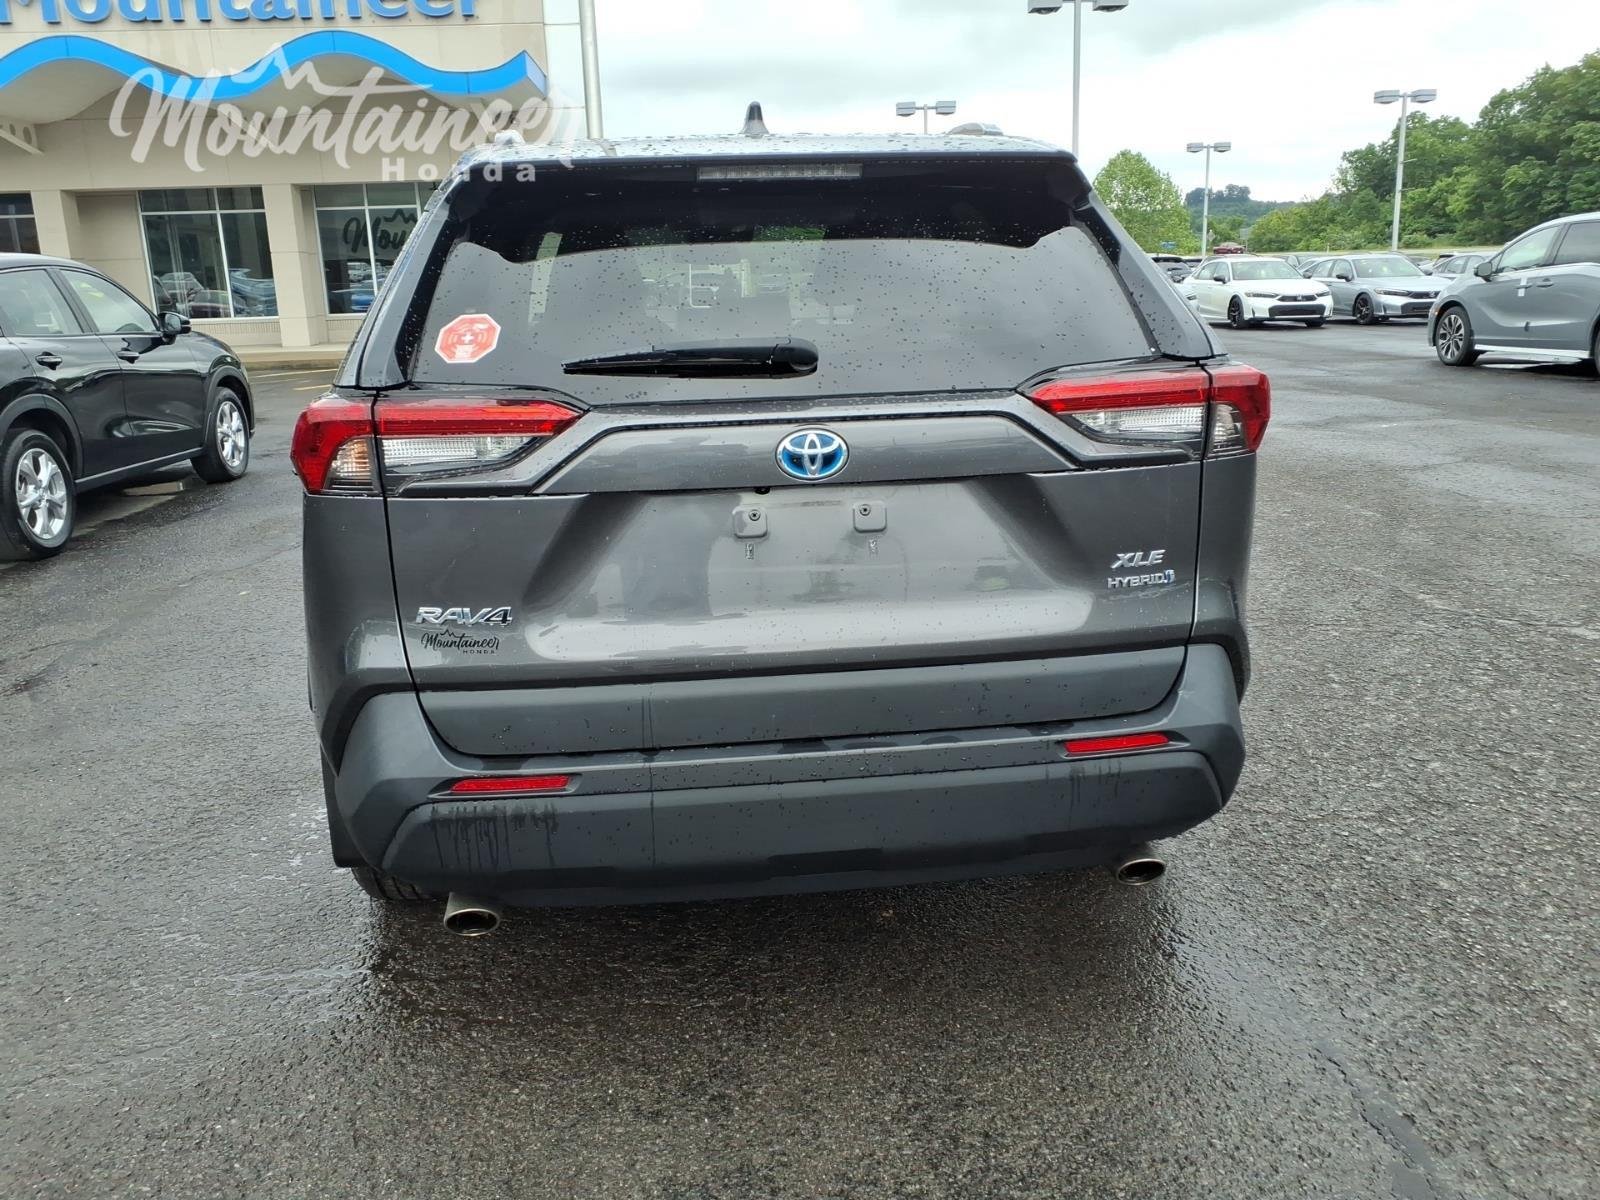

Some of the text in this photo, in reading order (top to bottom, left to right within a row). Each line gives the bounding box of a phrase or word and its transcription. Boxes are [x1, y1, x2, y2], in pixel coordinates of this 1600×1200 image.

[1110, 549, 1166, 569] XLE
[1107, 573, 1167, 588] HYBRID
[416, 606, 513, 627] RAV4
[420, 628, 500, 651] Mountaineer
